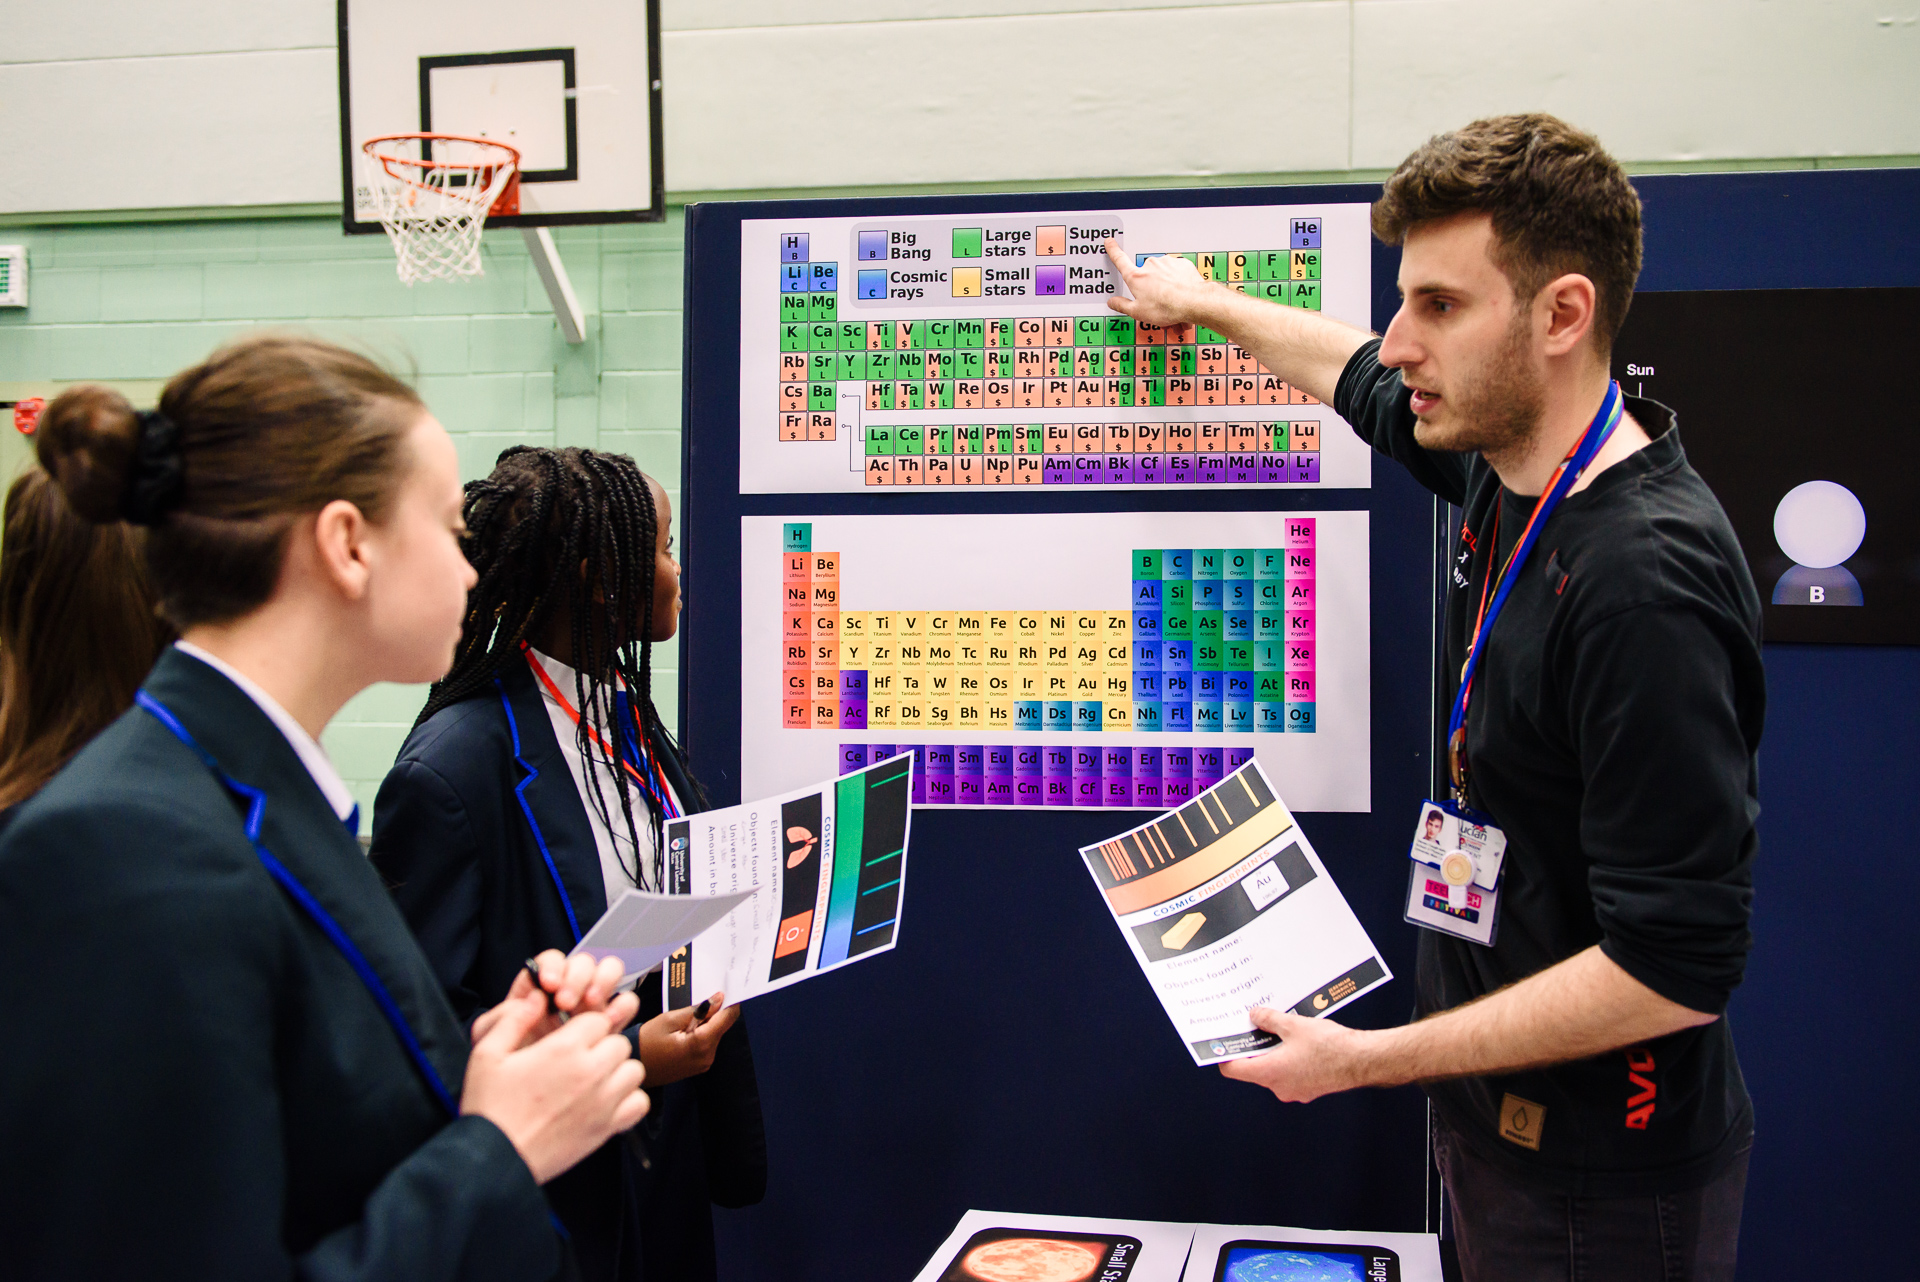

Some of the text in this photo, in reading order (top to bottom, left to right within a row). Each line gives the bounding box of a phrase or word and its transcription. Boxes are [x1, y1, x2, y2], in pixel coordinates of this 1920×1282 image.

[788, 222, 1317, 248] H He
[891, 231, 916, 246] Big
[985, 230, 1031, 244] Large
[1070, 227, 1123, 241] Super-
[891, 247, 931, 261] Bang
[985, 245, 1026, 257] stars
[789, 253, 1317, 278] Li Be N O F Ne
[1070, 267, 1110, 279] Man-
[891, 271, 947, 283] Cosmic
[985, 268, 1030, 280] Small
[891, 286, 923, 300] rays
[985, 284, 1026, 296] stars
[1070, 282, 1114, 294] made
[785, 284, 1315, 310] Na Mg Cl Ar
[788, 319, 1130, 338] K Ca Sc Ti V Cr Mn Fe Co Ni Cu Zn
[1626, 364, 1654, 376] Sun
[871, 424, 1314, 440] La Ce Pr Nd Pm Sm Eu Gd Tb Dy Ho Er Tm Yb Lu
[793, 525, 1310, 540] H He
[792, 556, 1310, 570] Li Be B C N O F Ne
[789, 585, 1309, 602] Na Mg Al Si P S Cl Ar
[1809, 586, 1825, 603] B
[793, 616, 1309, 628] K Ca Sc Ti V Cr Mn Fe Co Ni Cu Zn Ga Ge As Se Br Kr
[749, 812, 758, 852] Objects
[708, 826, 716, 865] Amount
[770, 820, 778, 862] Element
[710, 869, 717, 878] in
[751, 855, 759, 886] found
[813, 816, 831, 941] COSMIC FINGERPRINTS
[1153, 895, 1196, 916] COSMIC
[1198, 850, 1270, 898] FINGERPRINTS
[1256, 875, 1272, 889] Au
[1430, 899, 1471, 919] FESTIVAL
[1166, 936, 1243, 969] Element name:
[1164, 976, 1205, 990] Objects
[1206, 962, 1237, 979] found
[1181, 973, 1264, 1006] Universe origin:
[1189, 1012, 1229, 1025] Amount
[1108, 1244, 1134, 1268] Small
[1368, 1257, 1391, 1282] Large
